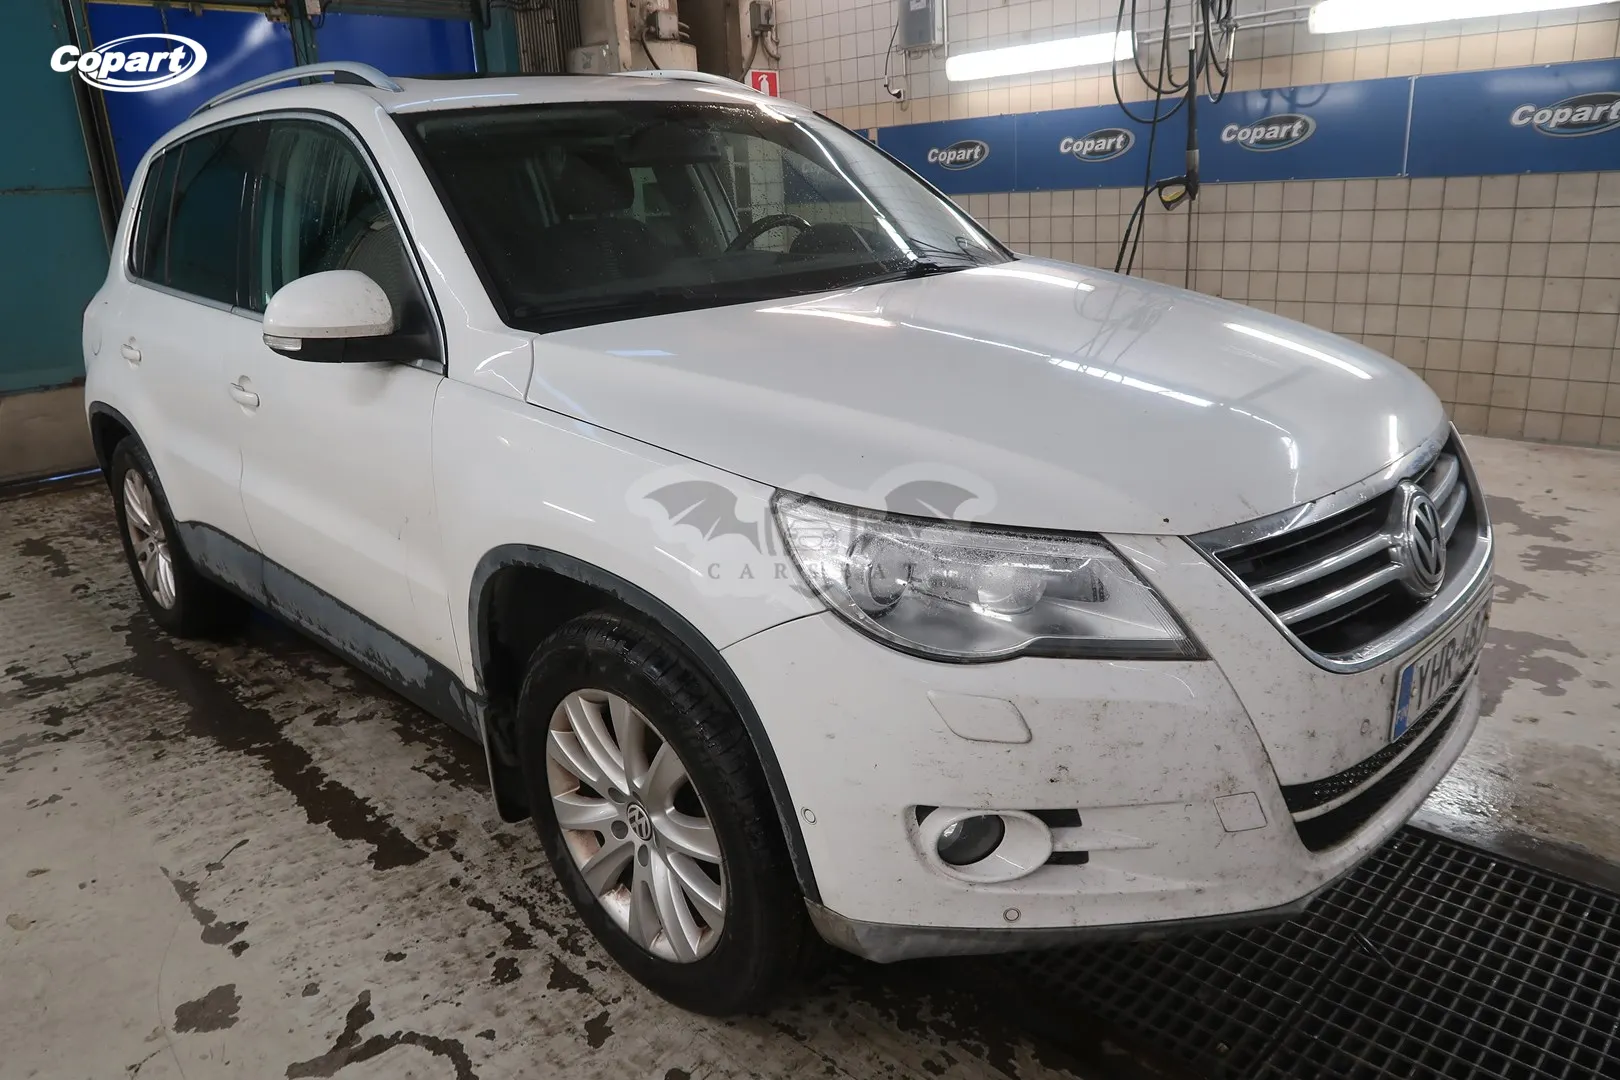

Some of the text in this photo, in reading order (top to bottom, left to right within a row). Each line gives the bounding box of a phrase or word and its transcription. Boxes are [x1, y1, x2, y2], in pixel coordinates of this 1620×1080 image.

[1511, 100, 1620, 128] Copart
[1221, 120, 1303, 144] Copart
[927, 145, 981, 164] Copart
[1060, 134, 1125, 155] Copart
